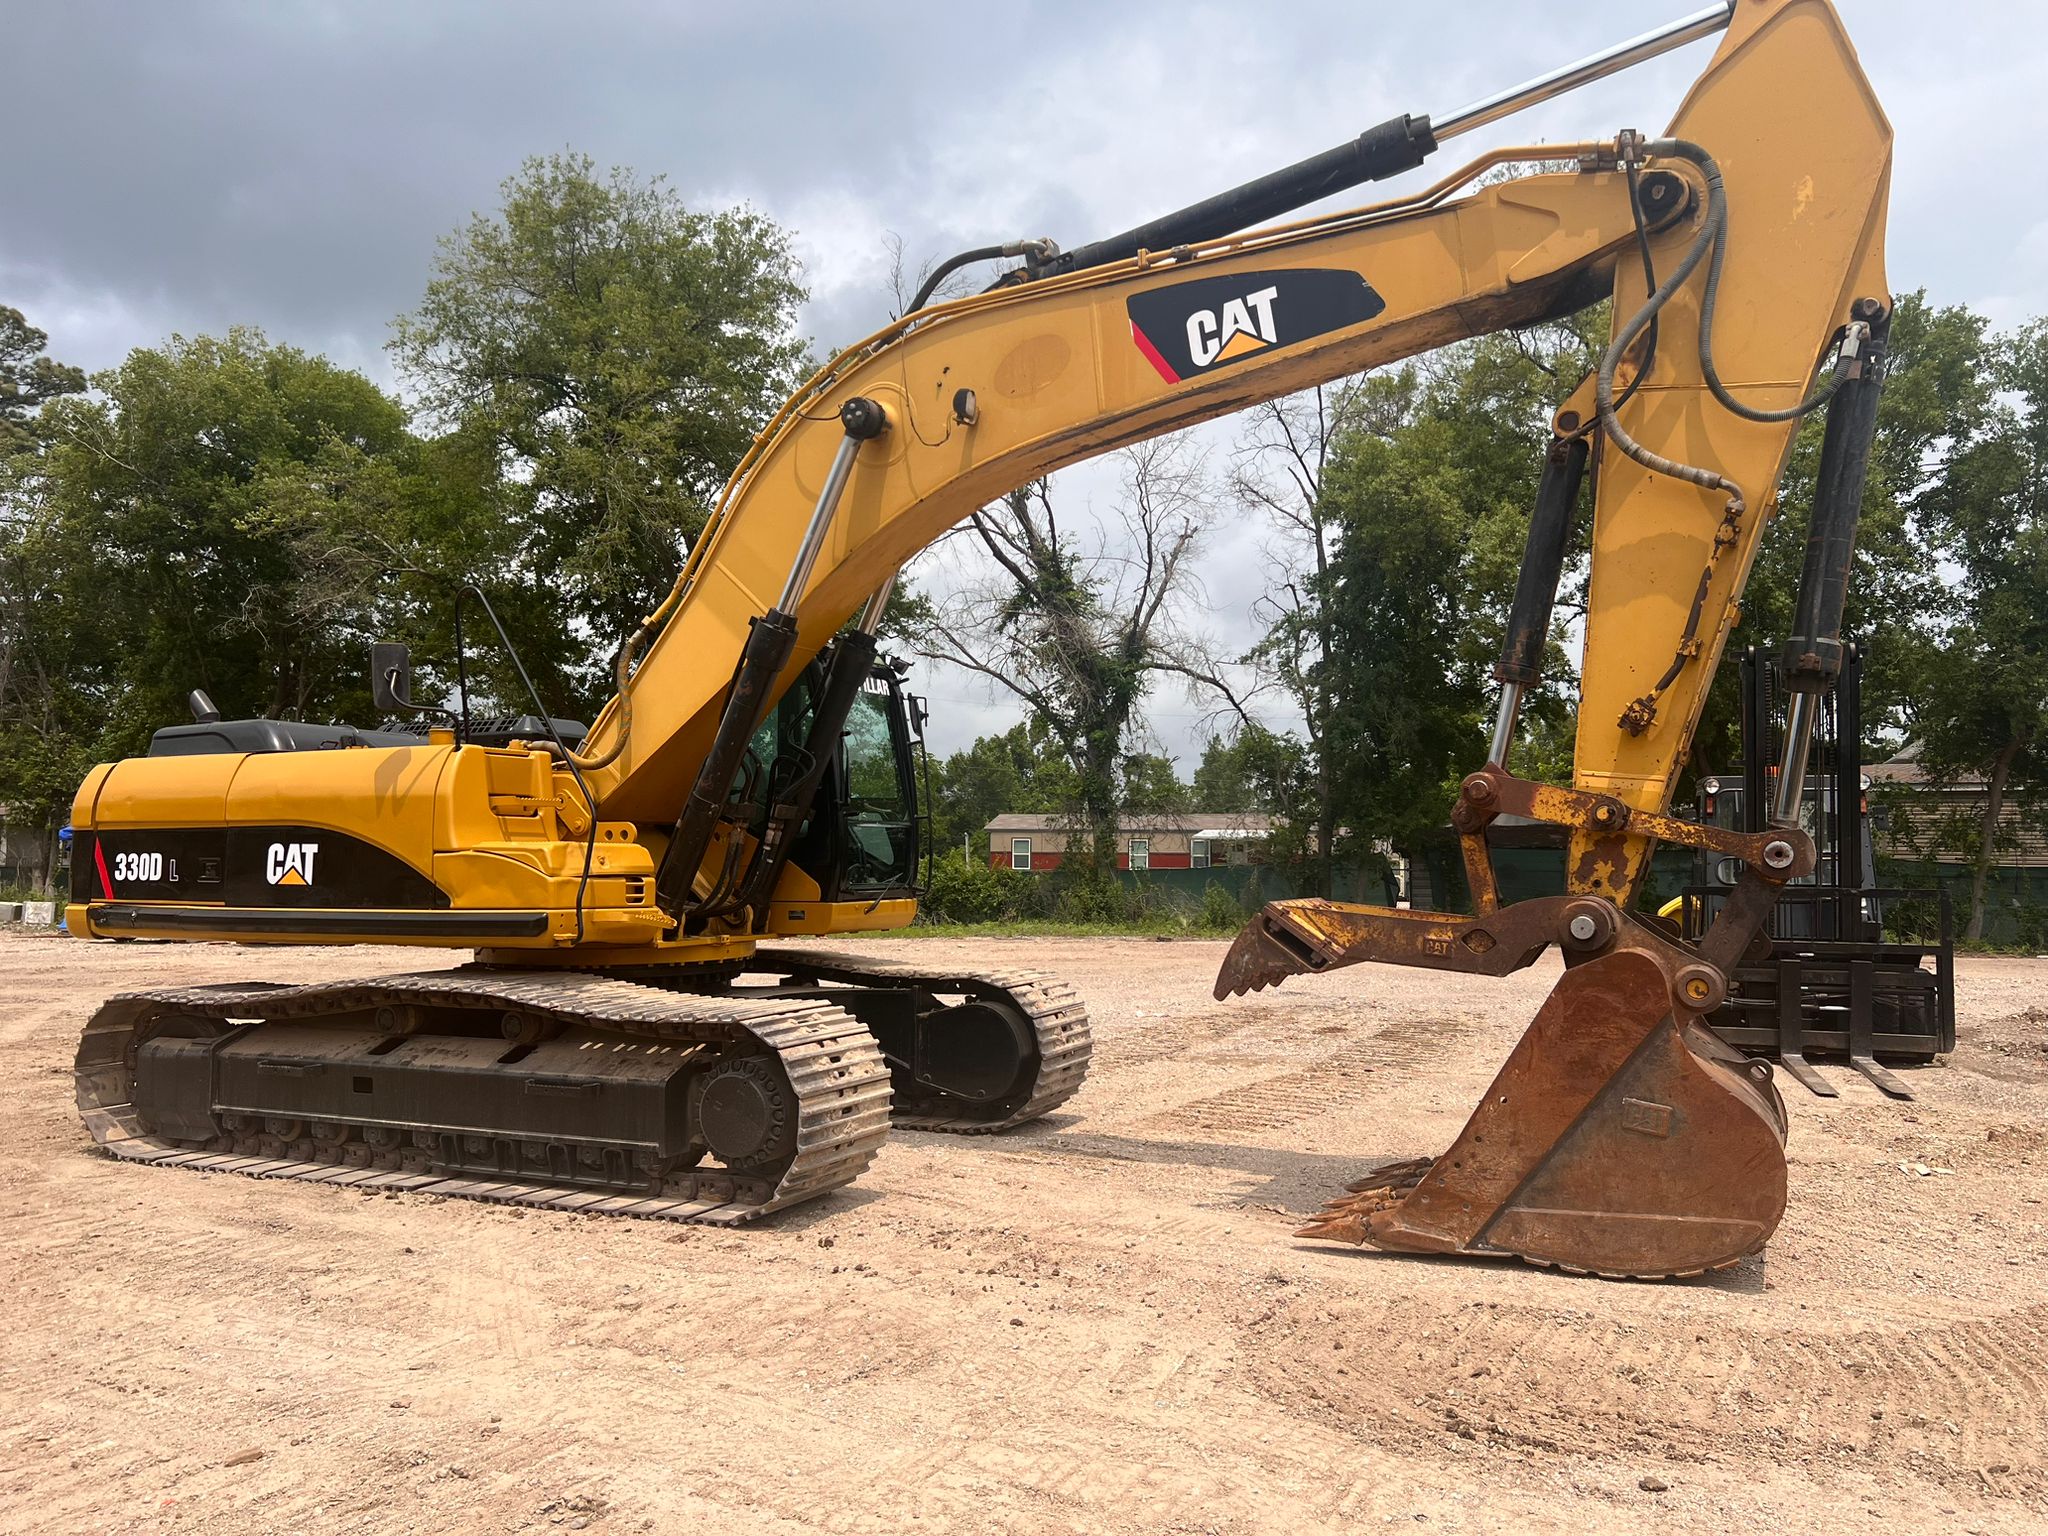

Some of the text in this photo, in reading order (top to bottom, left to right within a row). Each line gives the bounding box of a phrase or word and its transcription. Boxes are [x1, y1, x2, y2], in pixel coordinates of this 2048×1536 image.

[1186, 285, 1278, 367] CAT
[858, 677, 890, 696] ILLAR
[115, 853, 179, 882] 330D L
[266, 843, 319, 886] CAT
